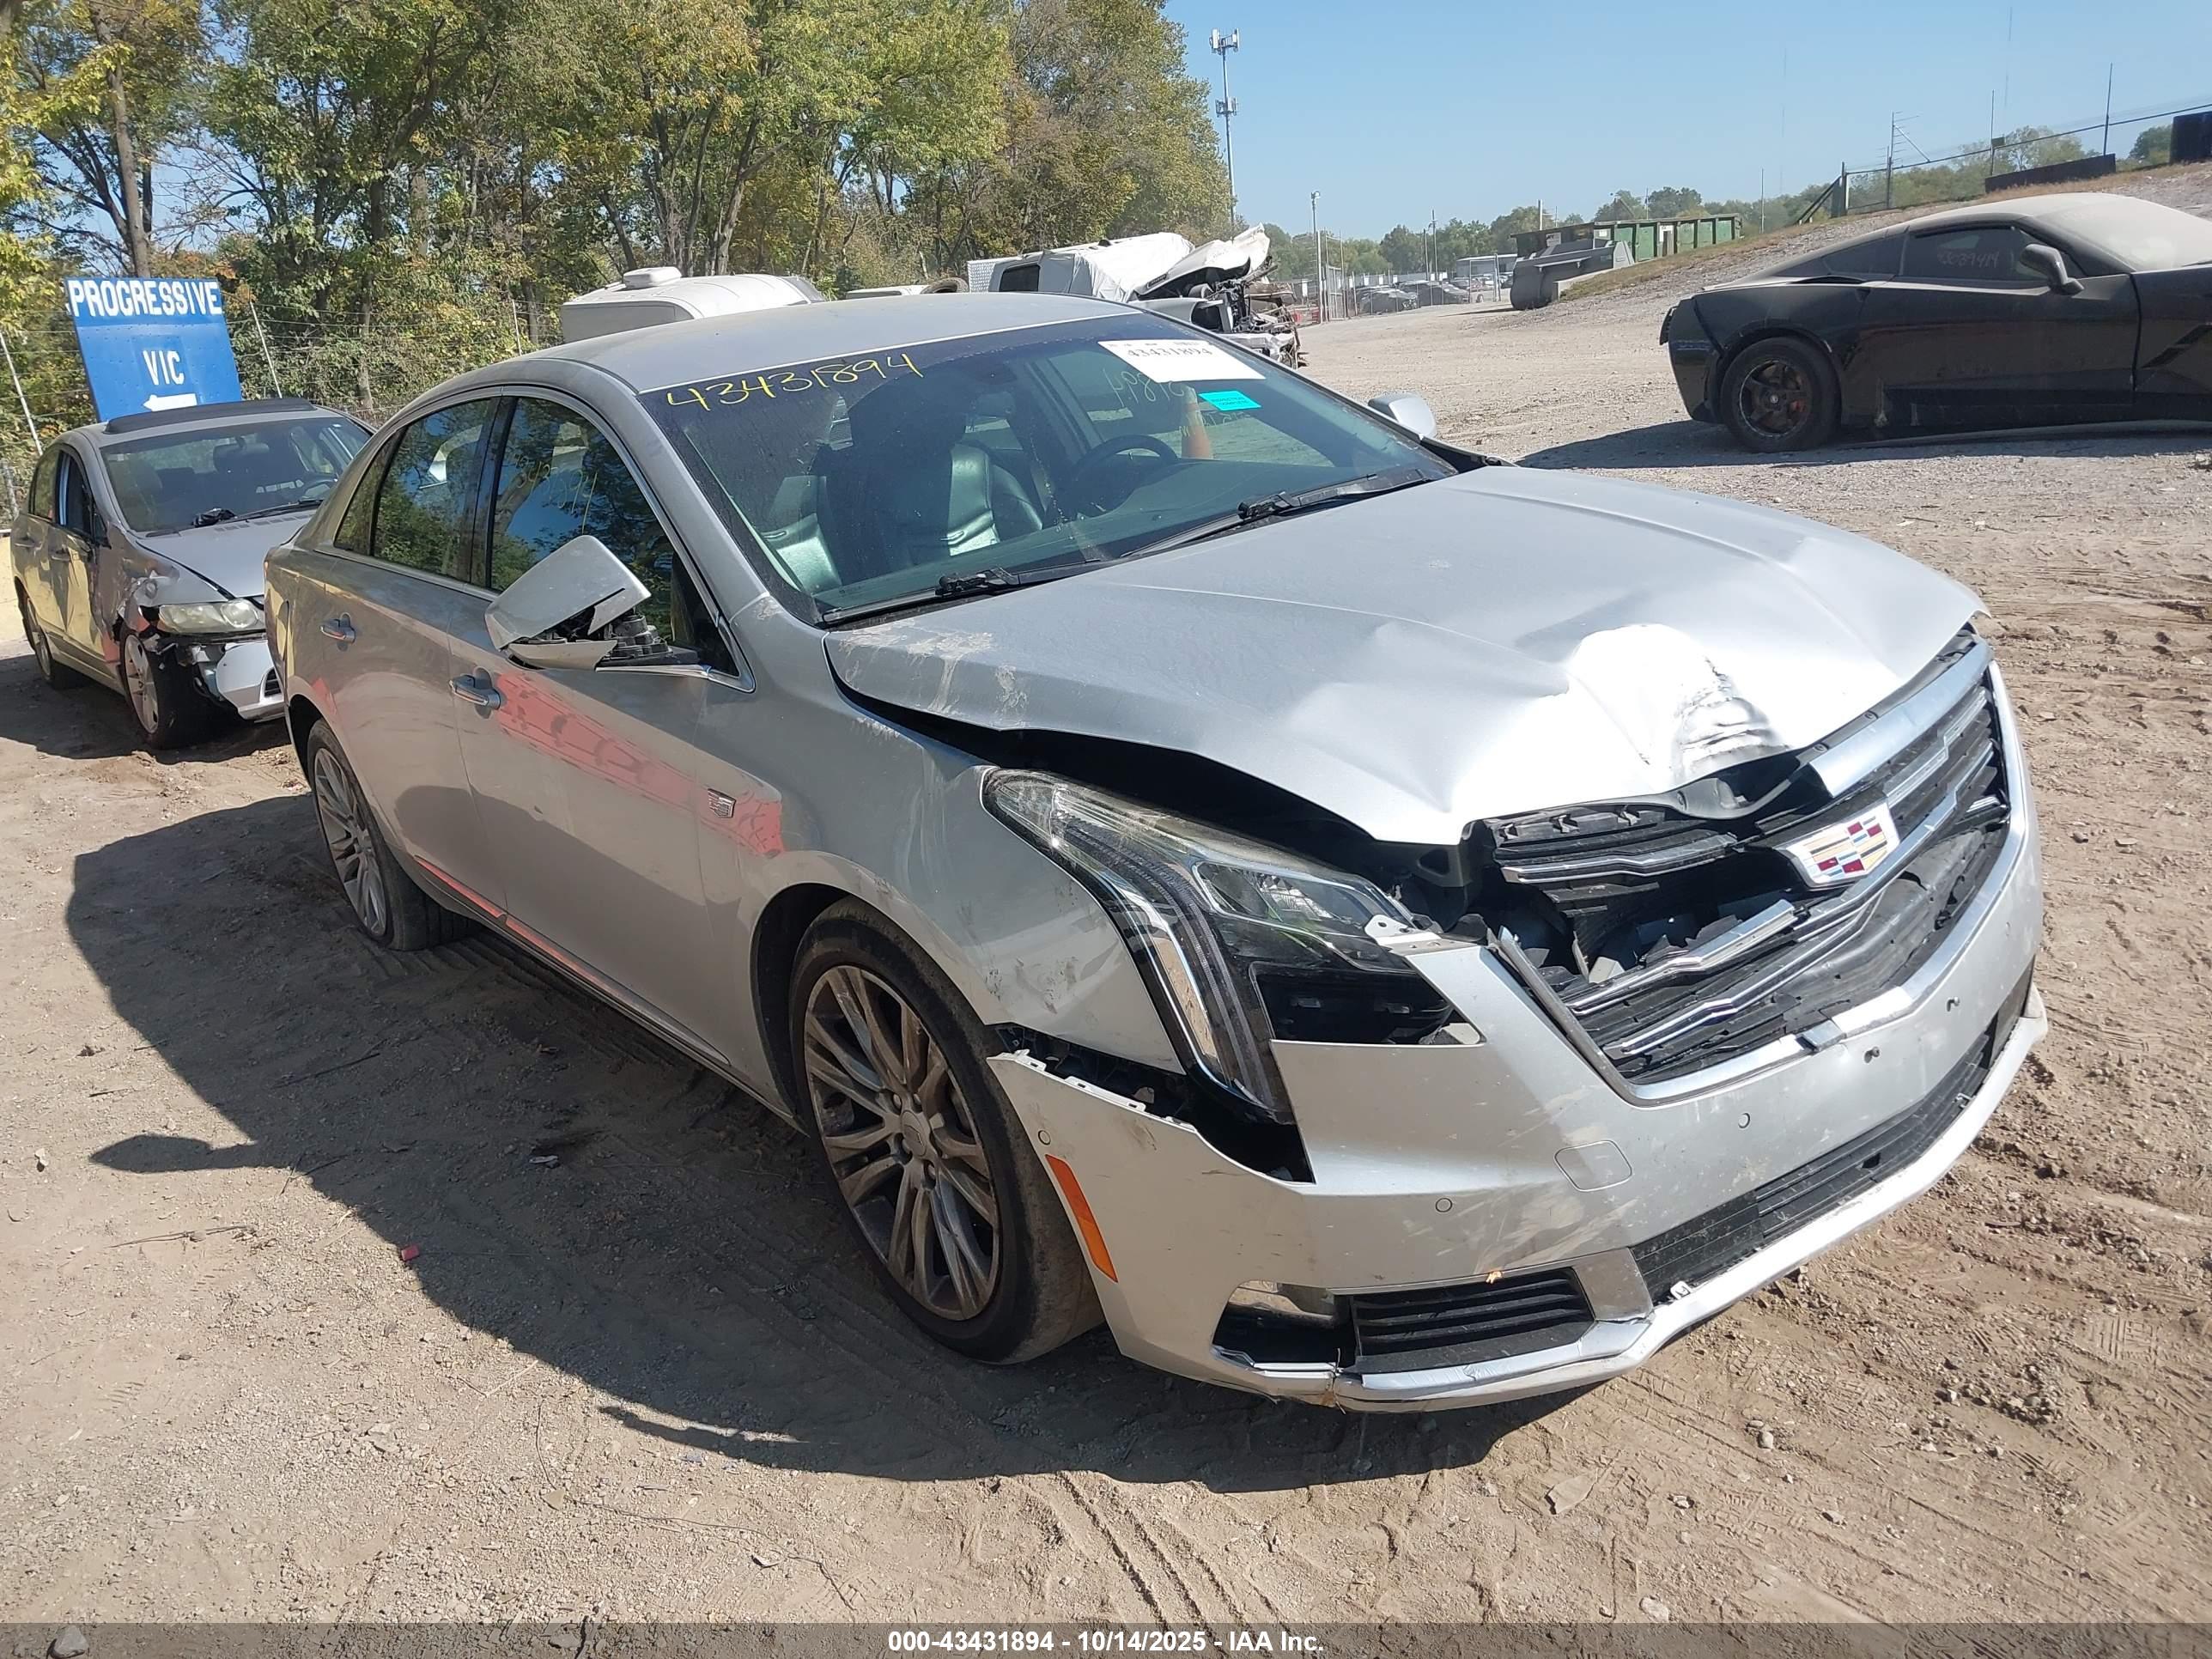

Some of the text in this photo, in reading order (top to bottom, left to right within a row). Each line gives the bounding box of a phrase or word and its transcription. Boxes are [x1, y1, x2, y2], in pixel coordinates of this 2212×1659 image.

[68, 280, 222, 317] PROGRESSIVE
[143, 349, 185, 386] VIC
[667, 353, 924, 411] 43431894
